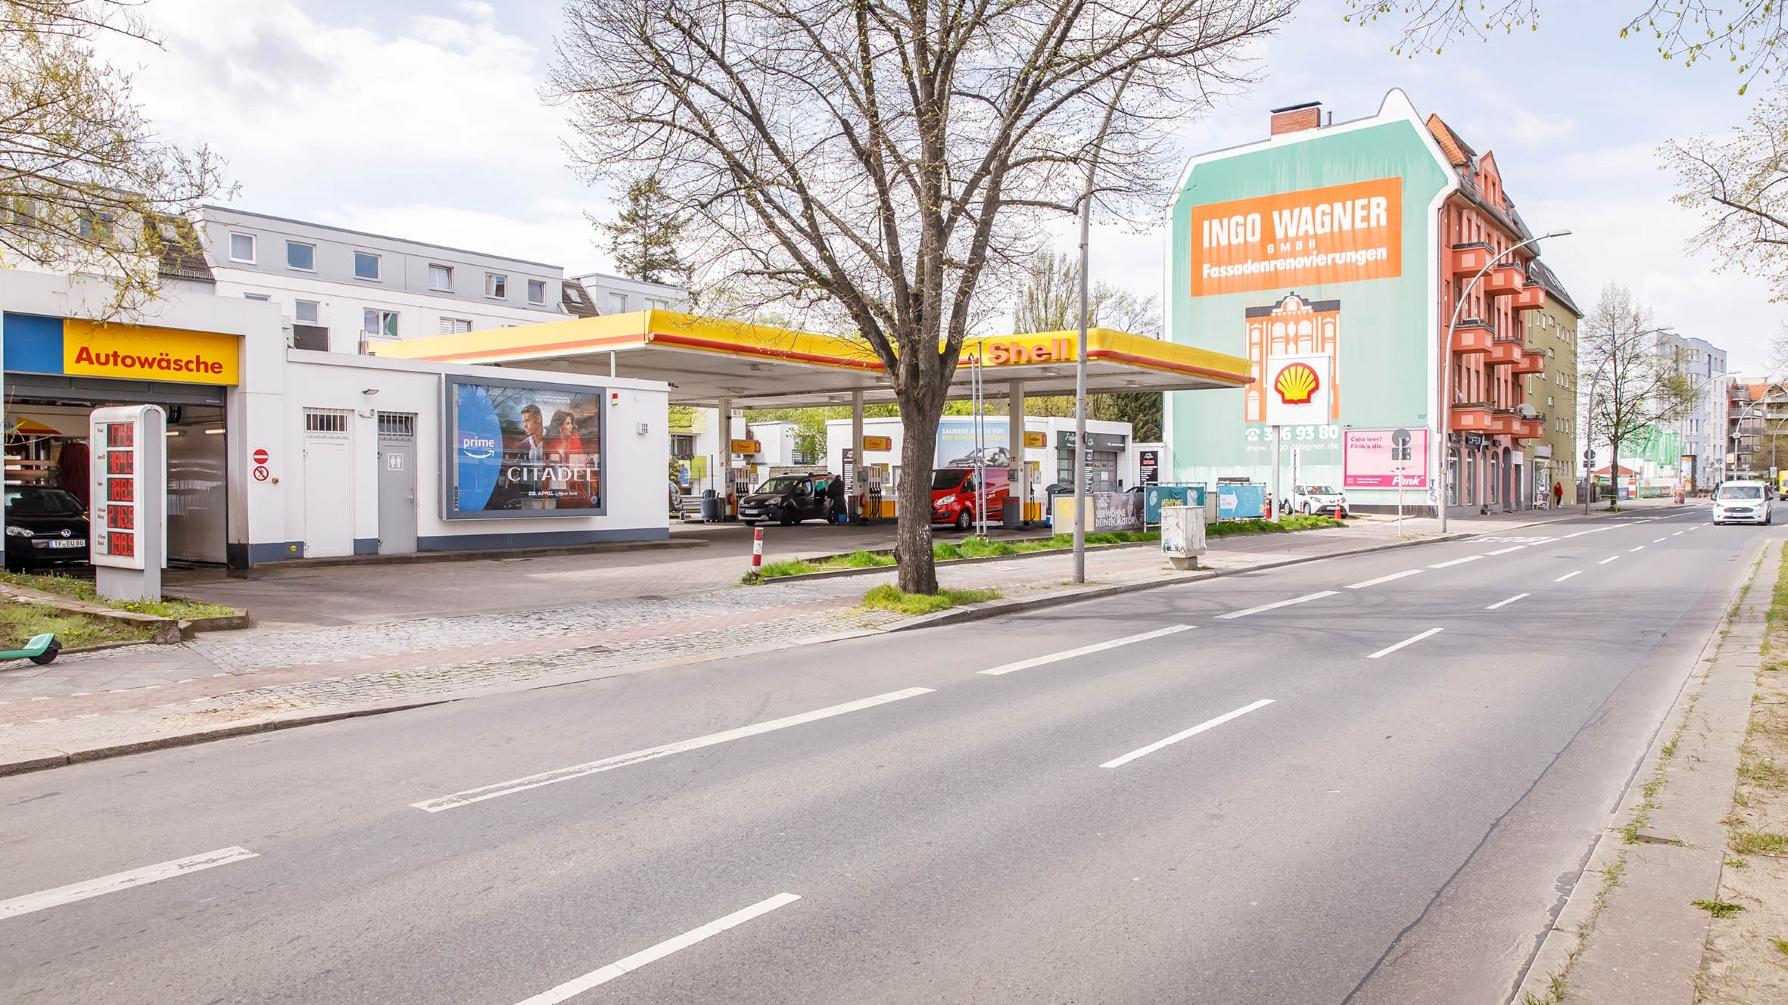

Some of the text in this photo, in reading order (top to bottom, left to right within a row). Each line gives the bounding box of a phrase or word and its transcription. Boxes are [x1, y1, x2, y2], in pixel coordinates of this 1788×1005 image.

[1203, 196, 1387, 248] INGO WAGNER
[1203, 247, 1387, 279] Fassadenrenovierungen
[75, 346, 223, 374] Autowäsche
[988, 338, 1070, 364] Shell
[463, 436, 495, 449] prime
[1263, 424, 1339, 441] 36 93 80
[507, 467, 598, 482] CITADEL
